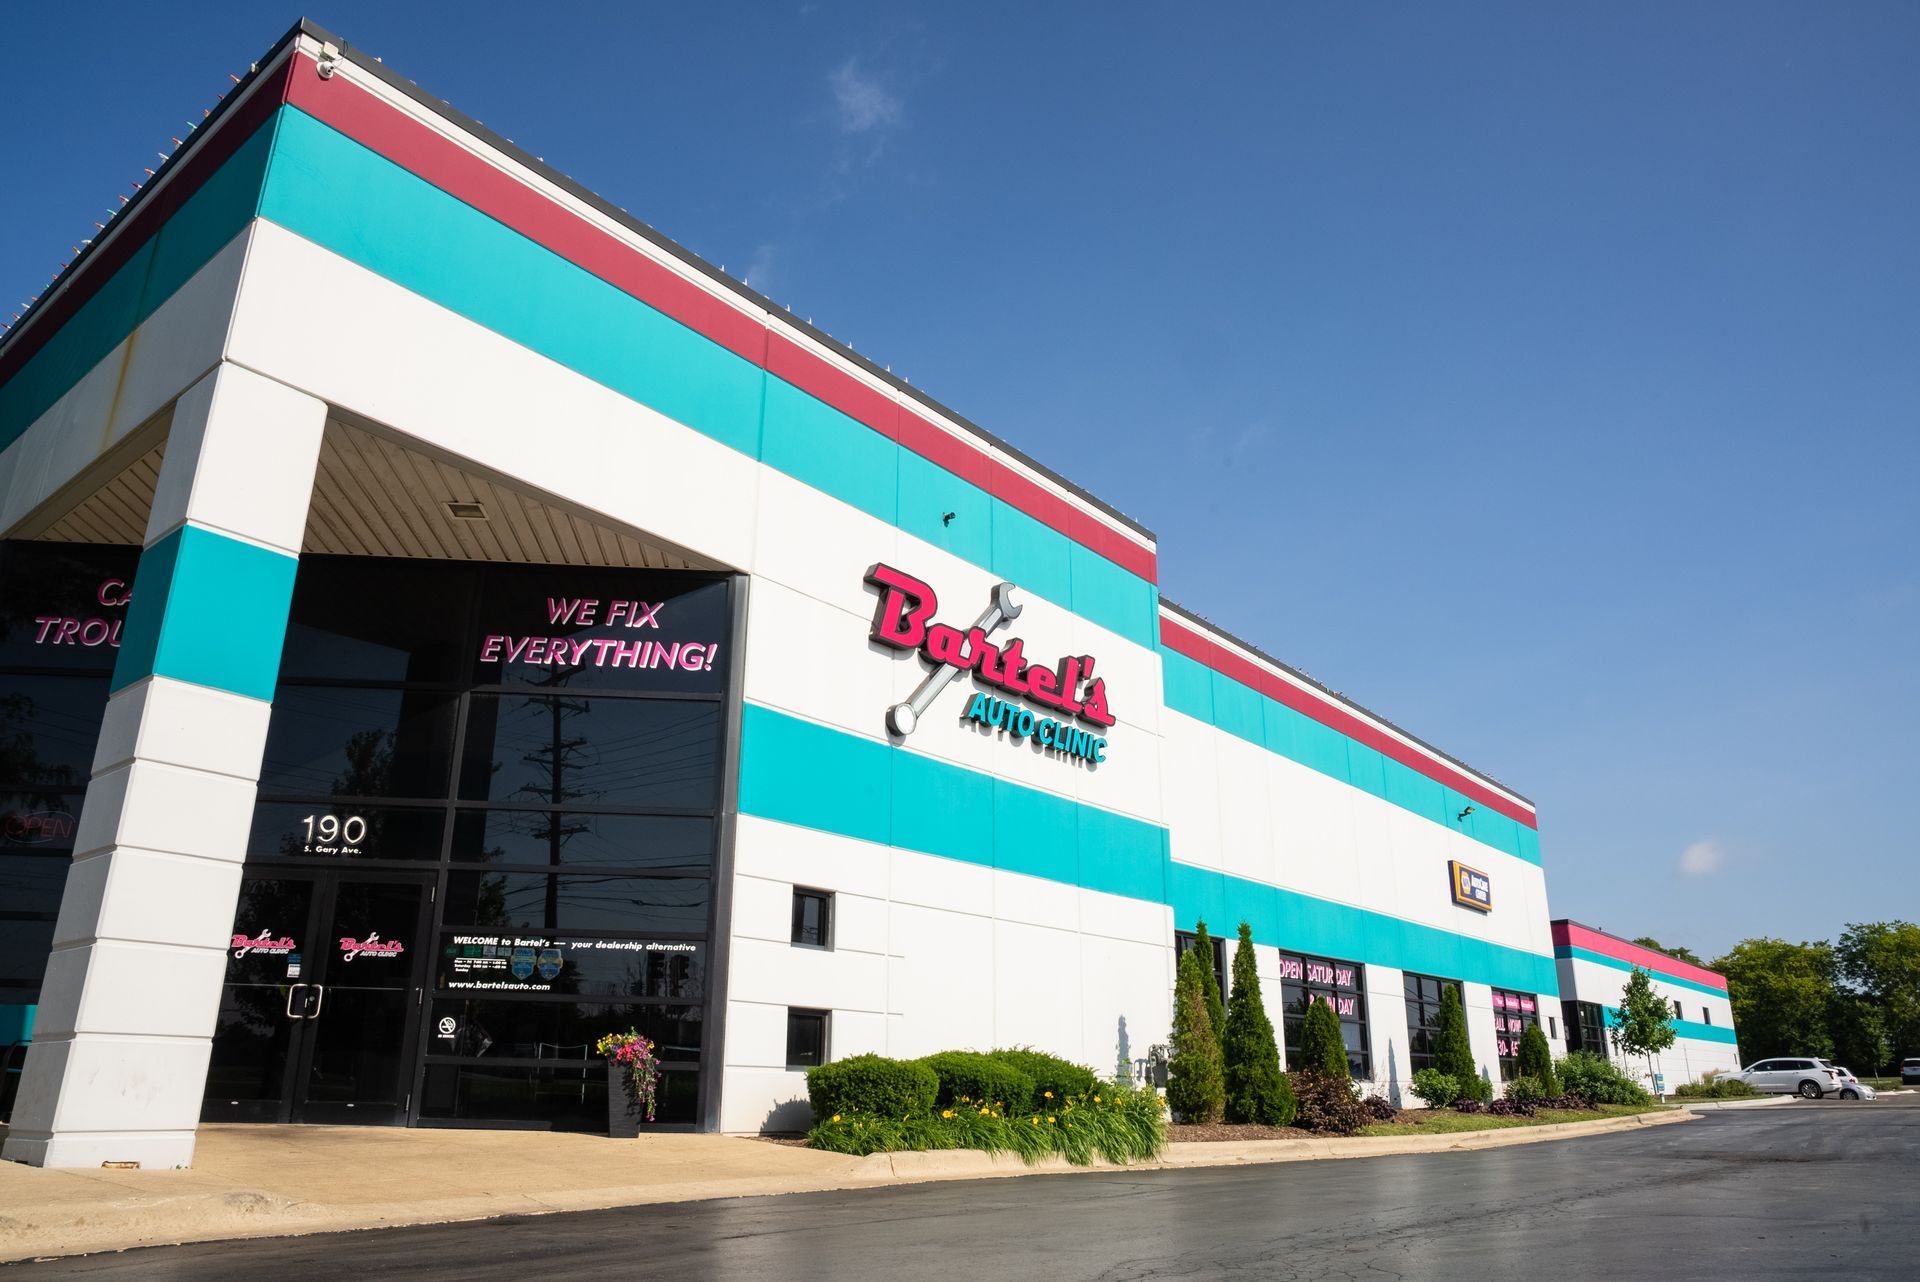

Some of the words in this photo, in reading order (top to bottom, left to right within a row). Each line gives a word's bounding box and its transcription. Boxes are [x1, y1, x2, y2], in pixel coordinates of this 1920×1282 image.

[546, 597, 599, 626] WE
[605, 600, 665, 629] FIX
[480, 635, 718, 673] EVERYTHING!
[863, 562, 1117, 728] Bartel's
[962, 692, 1036, 738] AUTO
[1038, 717, 1108, 764] CLINIC
[6, 815, 74, 839] OPEN
[302, 815, 368, 845] 190
[315, 845, 338, 855] Gary
[341, 846, 362, 855] Ave.
[453, 936, 500, 946] WELCOME
[501, 938, 511, 946] to
[514, 938, 550, 948] Bartel's
[571, 942, 593, 950] your
[596, 941, 643, 952] dealership
[646, 942, 697, 952] alternative
[1279, 959, 1304, 980] OPEN
[448, 981, 551, 991] www.bartelsauto.com
